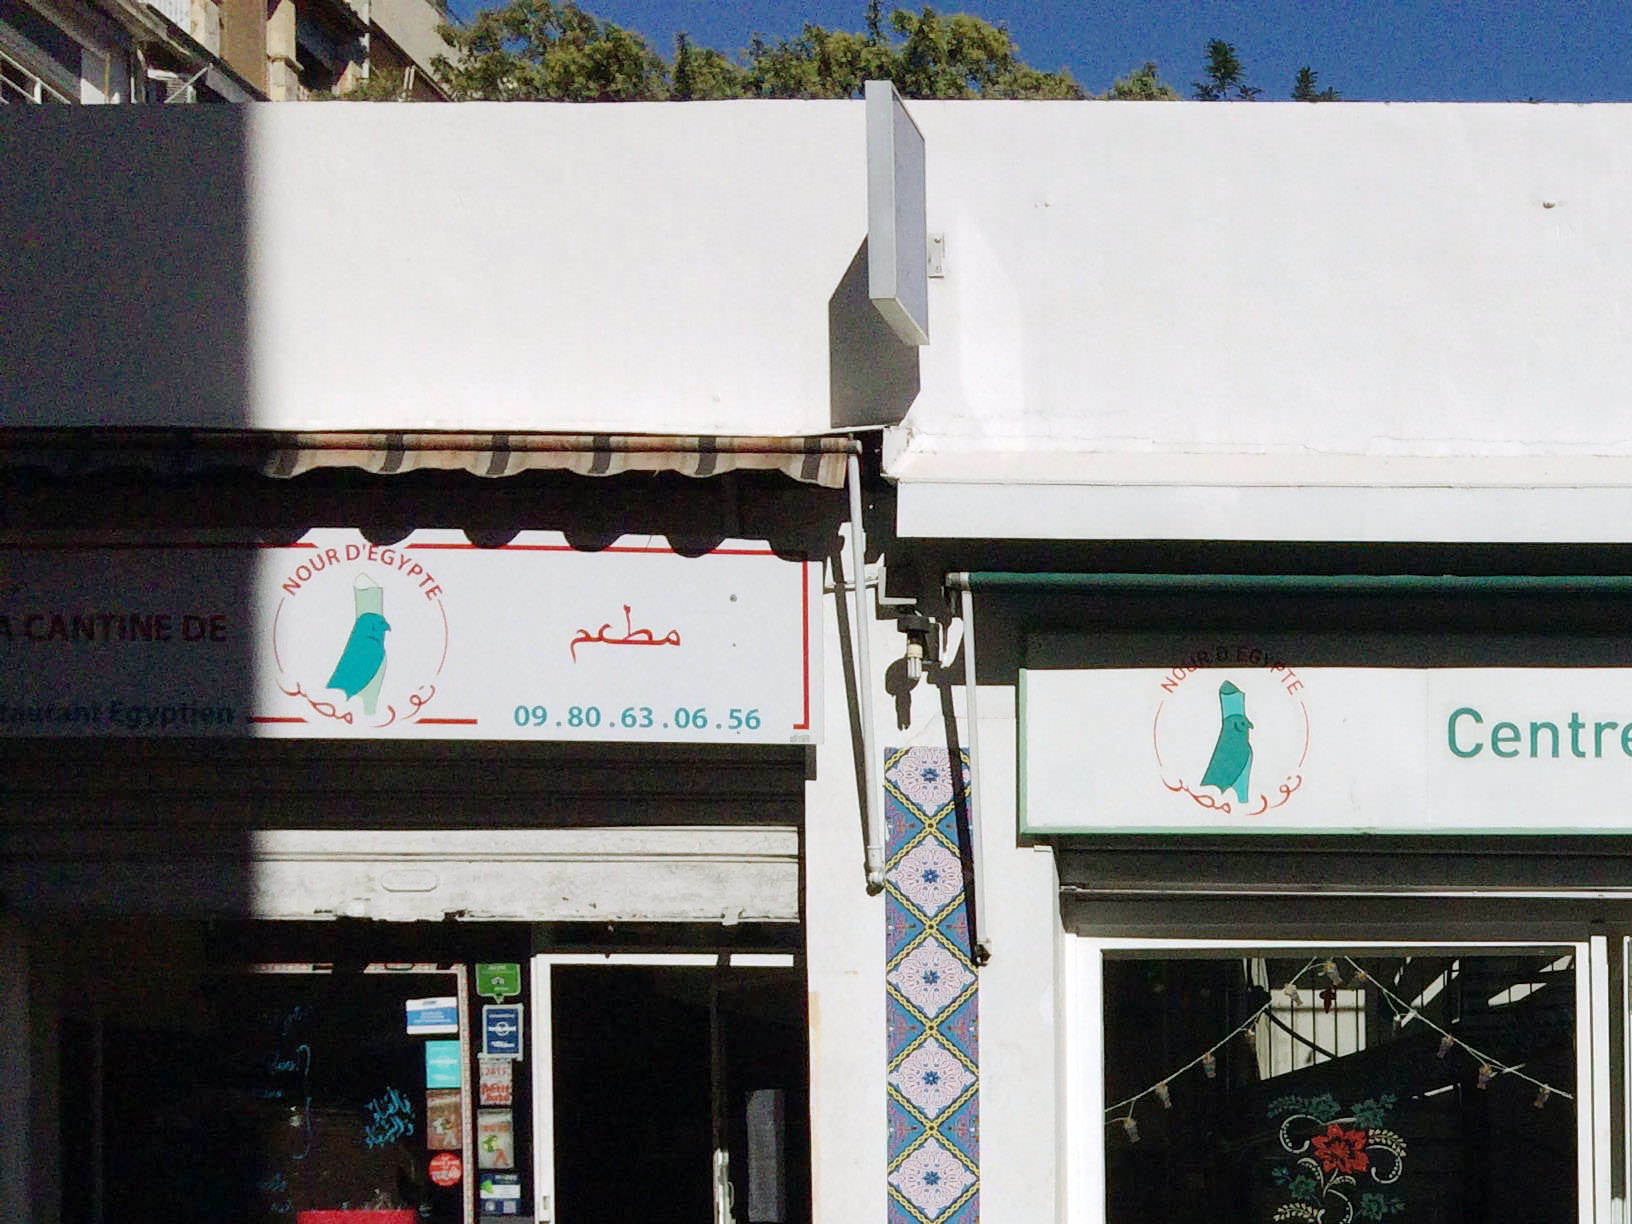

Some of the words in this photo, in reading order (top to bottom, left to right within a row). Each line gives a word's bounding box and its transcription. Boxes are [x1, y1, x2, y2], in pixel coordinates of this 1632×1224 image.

[282, 548, 341, 596] NOUR
[25, 614, 172, 642] CANTINE
[182, 614, 227, 642] DE
[570, 604, 680, 664] مطعم
[109, 701, 235, 730] Egyptien
[276, 682, 353, 725] مصر
[1160, 774, 1232, 815] مصر
